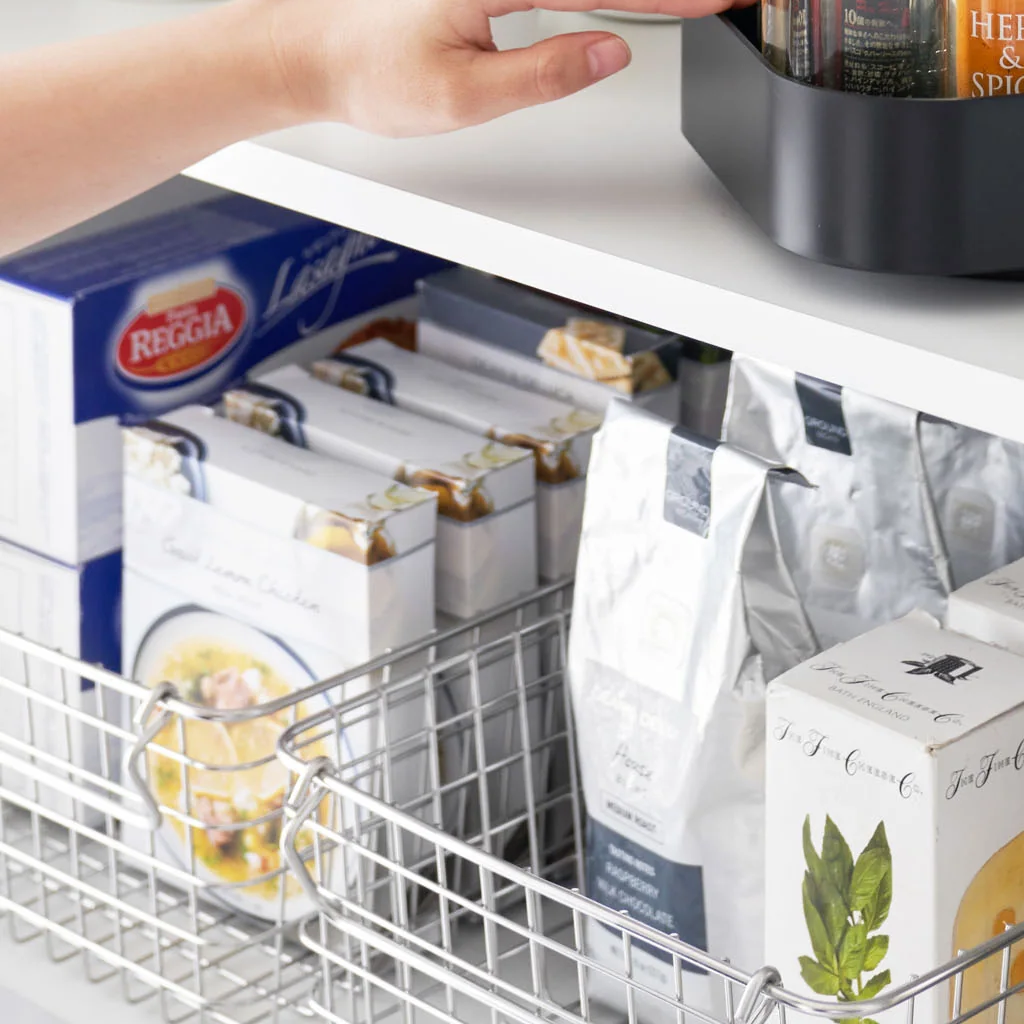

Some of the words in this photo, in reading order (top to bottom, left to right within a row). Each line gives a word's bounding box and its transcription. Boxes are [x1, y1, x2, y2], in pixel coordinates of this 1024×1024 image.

[999, 46, 1024, 70] &
[129, 303, 234, 364] REGGIA
[828, 684, 858, 701] BATH
[857, 696, 910, 722] ENGLAND
[605, 860, 660, 900] RASPBERRY
[617, 889, 676, 929] CHOCOLATE
